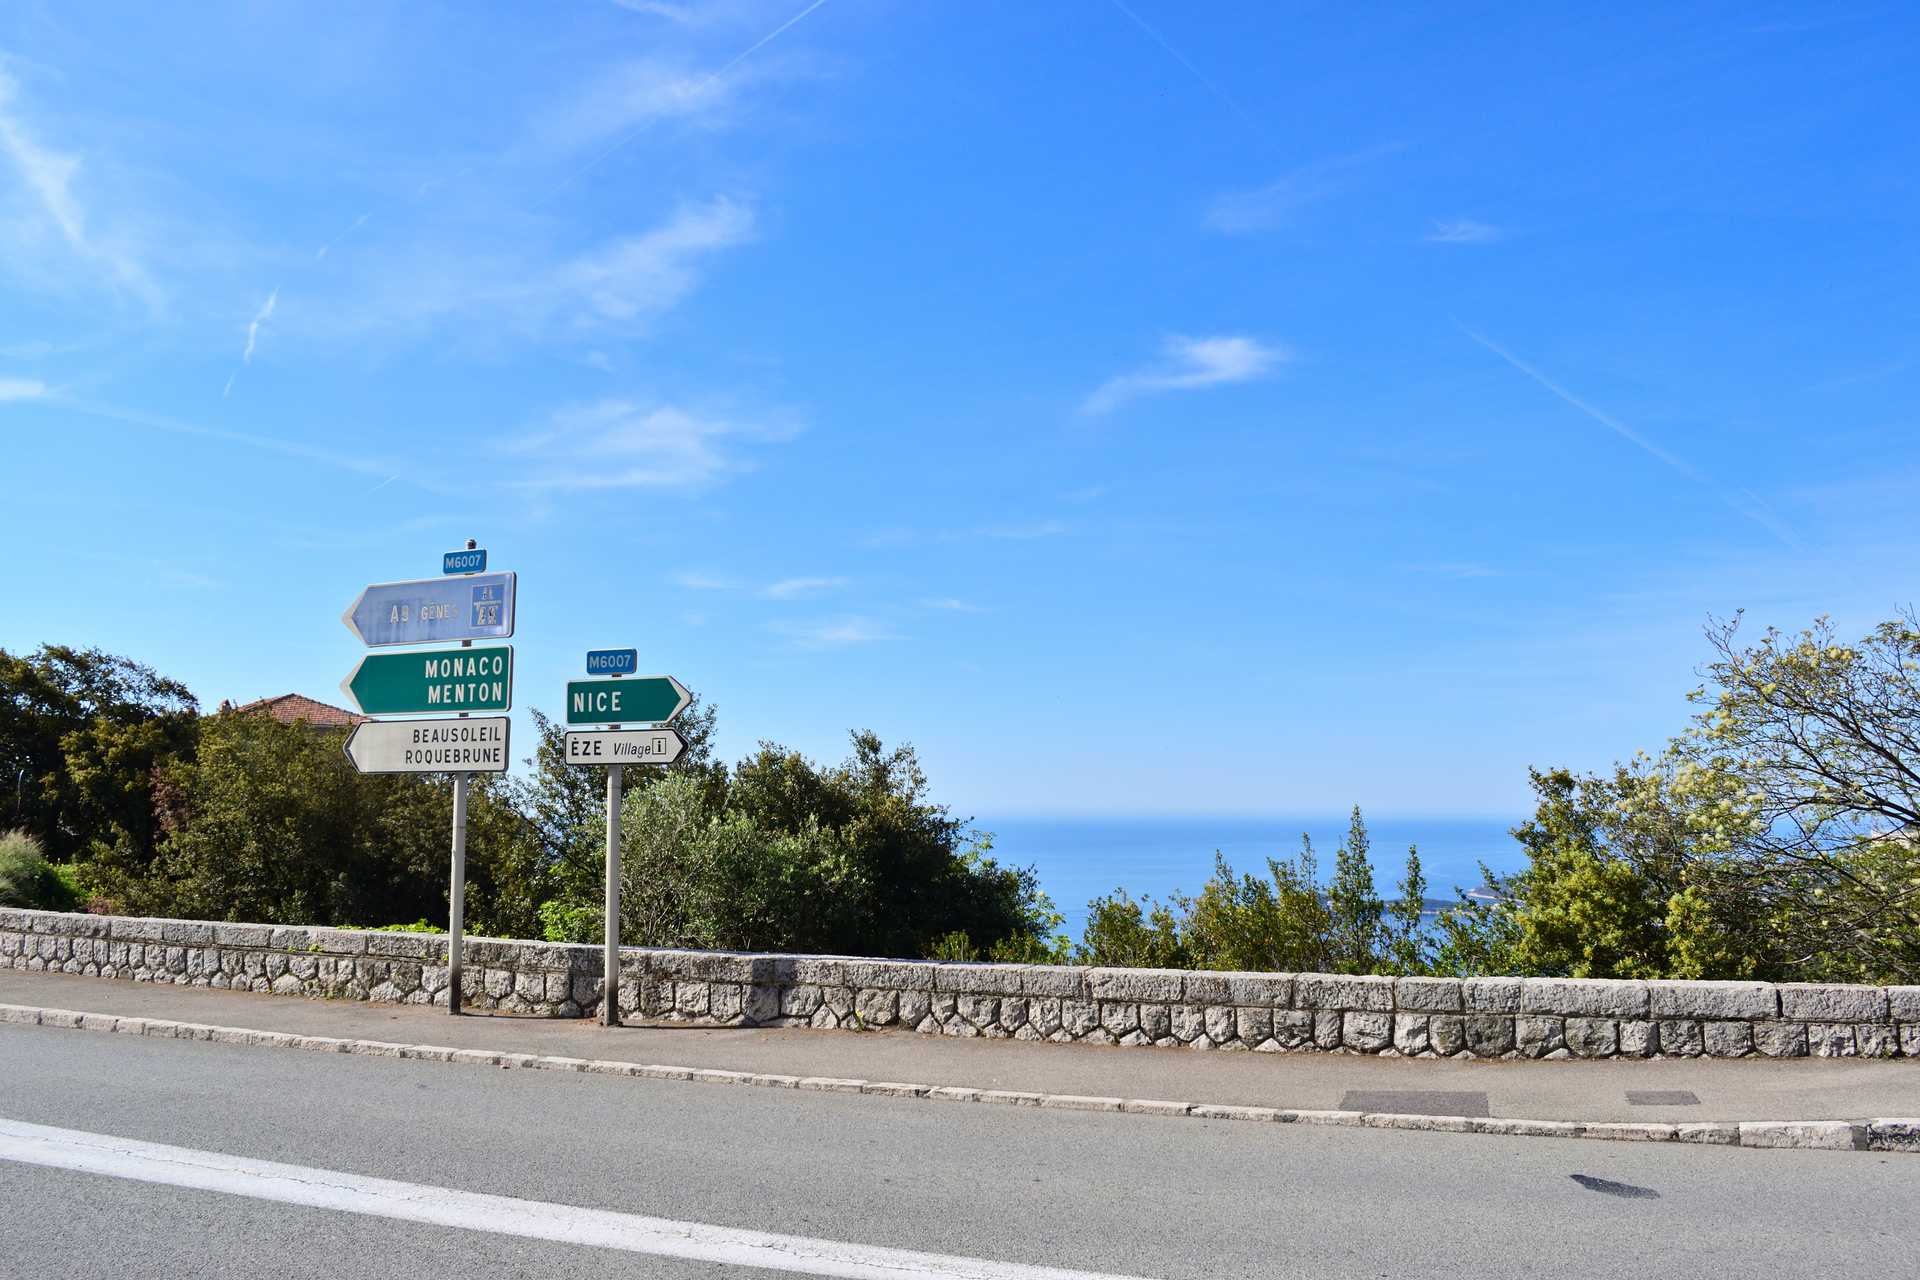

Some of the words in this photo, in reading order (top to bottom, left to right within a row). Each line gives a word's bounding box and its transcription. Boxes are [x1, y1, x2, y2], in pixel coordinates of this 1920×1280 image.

[445, 554, 481, 569] M6007
[425, 656, 503, 678] MONACO
[589, 654, 631, 669] M6007
[428, 682, 502, 704] MENTON
[573, 691, 622, 713] NICE
[413, 726, 501, 743] BEAUSOLEIL
[405, 748, 500, 765] ROQUEBRUNE
[613, 742, 651, 759] Village
